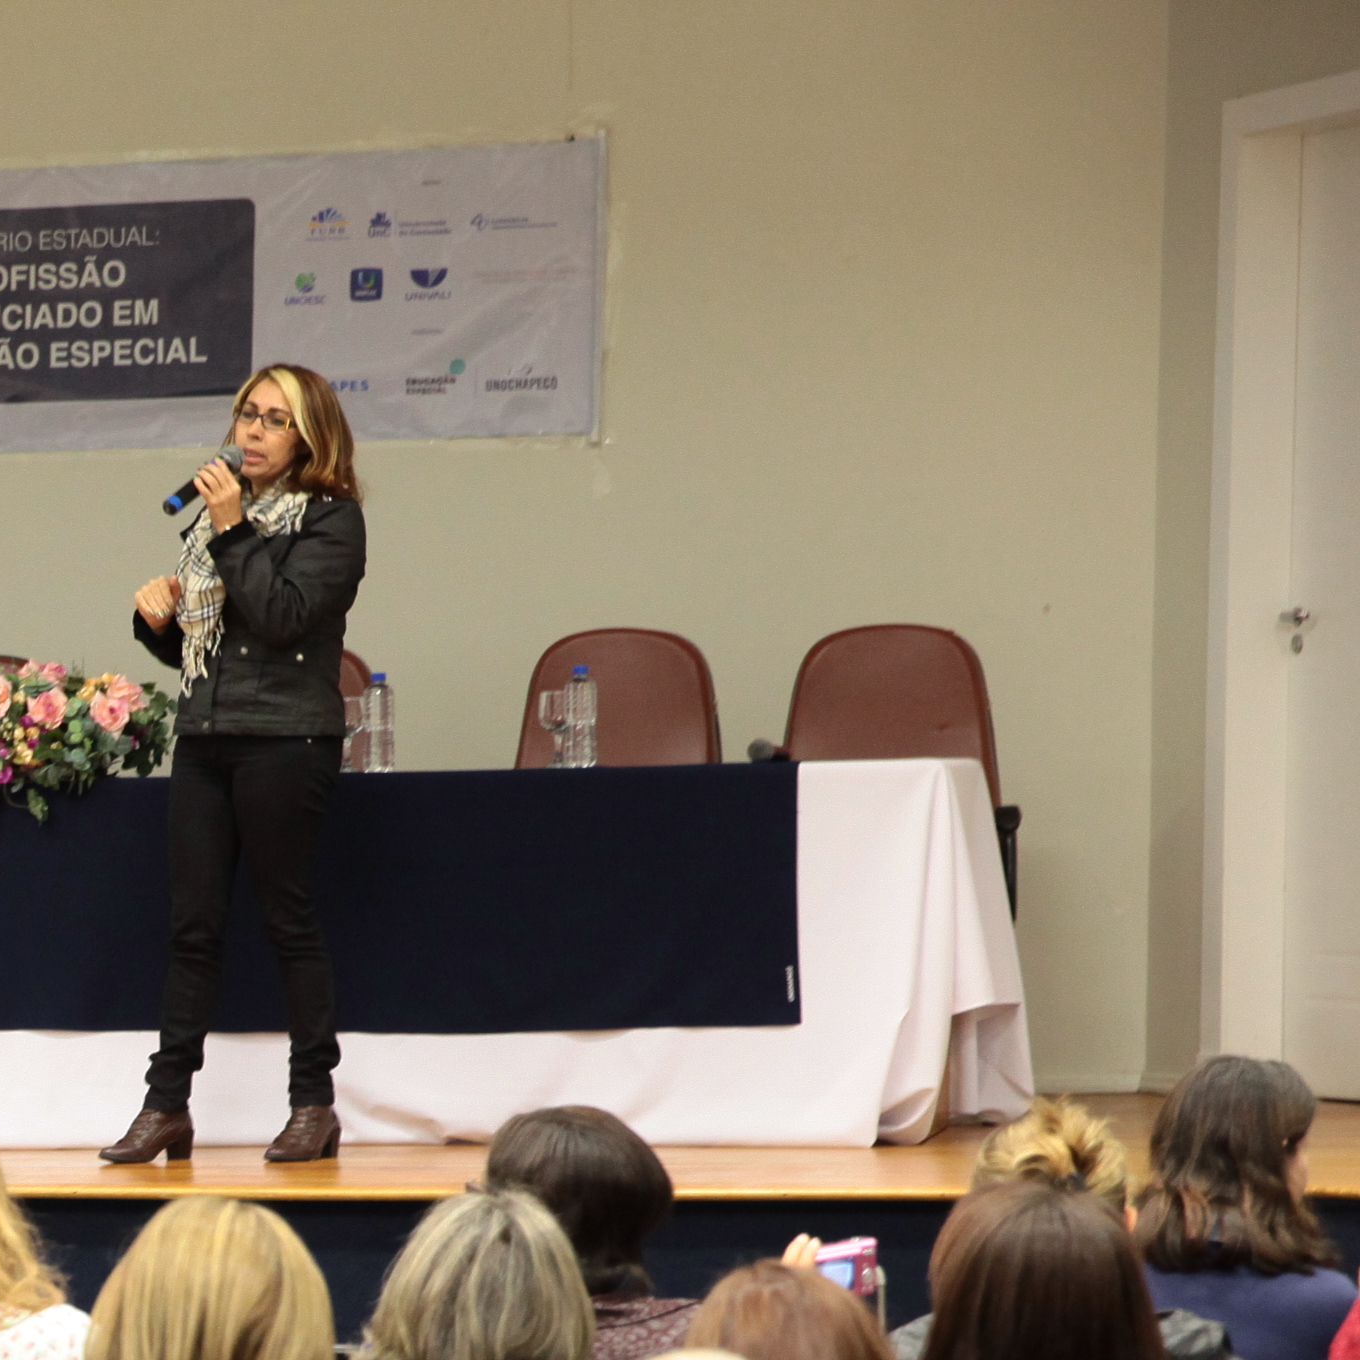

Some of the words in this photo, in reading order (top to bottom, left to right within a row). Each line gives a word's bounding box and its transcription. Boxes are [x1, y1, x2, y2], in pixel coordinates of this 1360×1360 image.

[38, 229, 161, 251] ESTADUAL:
[113, 299, 158, 326] EM
[50, 338, 208, 368] ESPECIAL
[330, 380, 369, 392] APES
